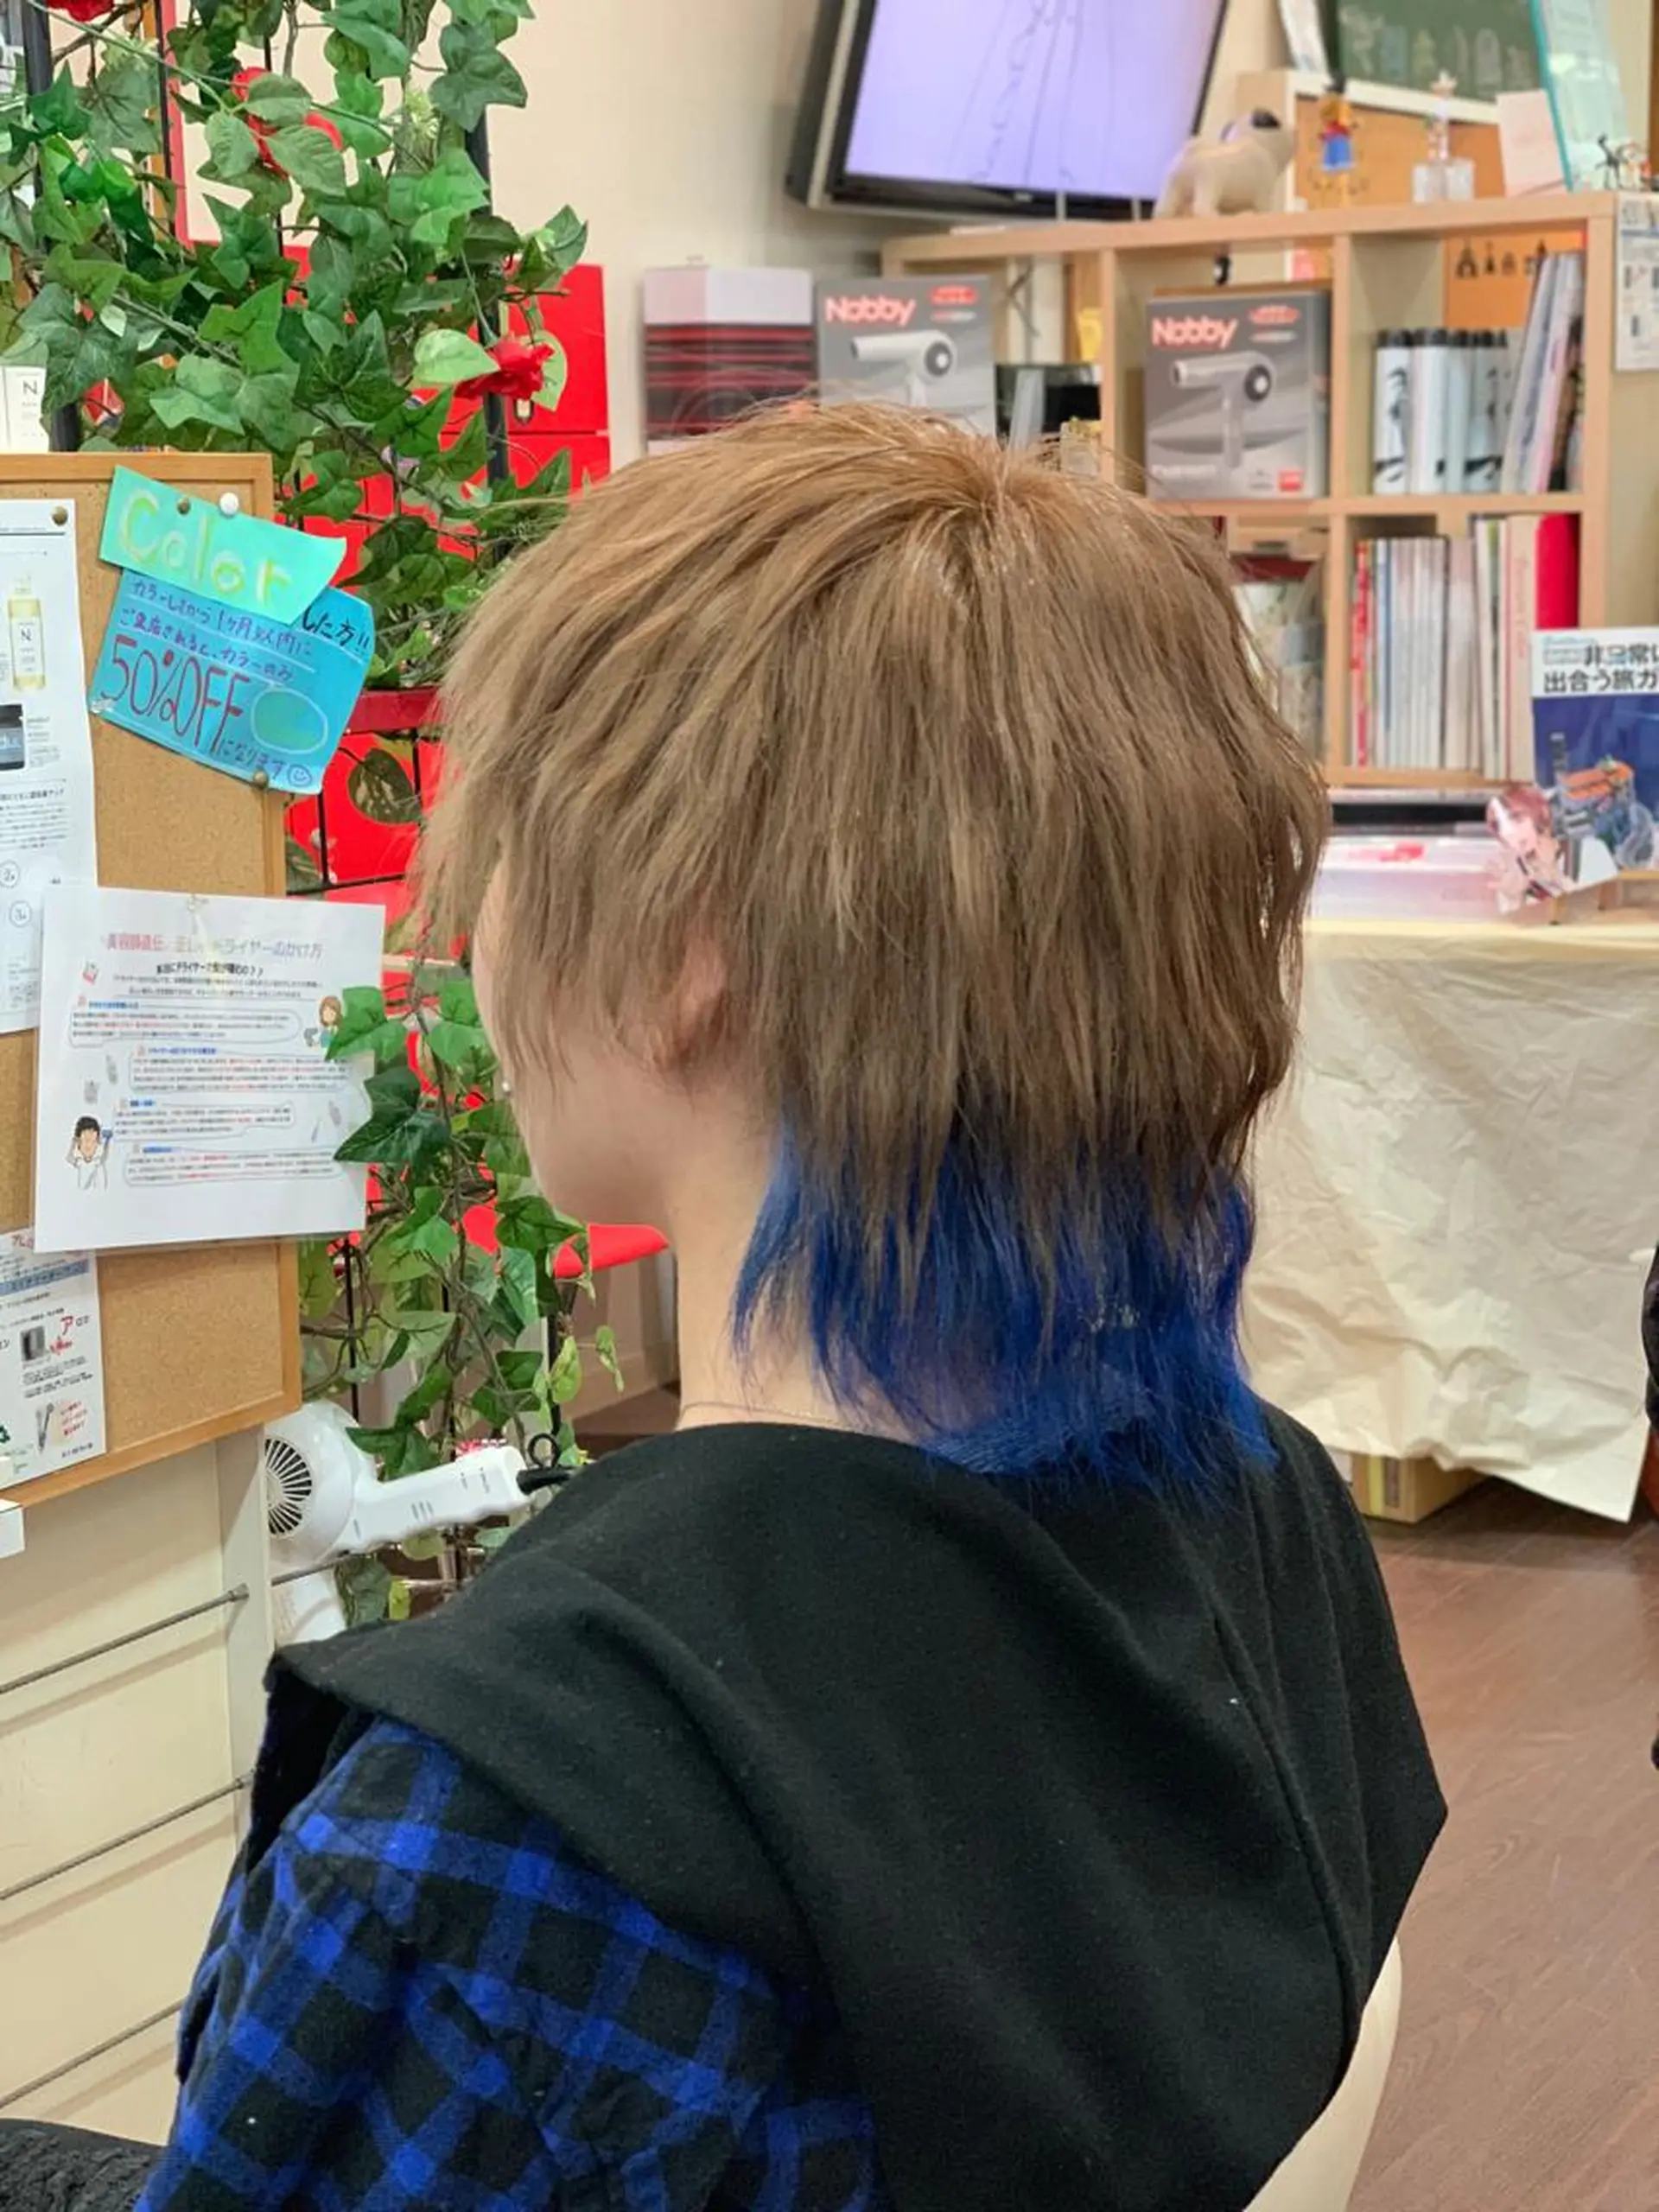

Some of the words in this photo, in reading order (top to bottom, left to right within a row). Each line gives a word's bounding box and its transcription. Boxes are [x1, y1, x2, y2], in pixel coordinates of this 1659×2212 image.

[824, 295, 917, 327] Nobby
[1151, 315, 1239, 350] Nobby
[22, 379, 39, 396] N
[119, 490, 292, 606] Color
[98, 632, 251, 755] 50%OFF
